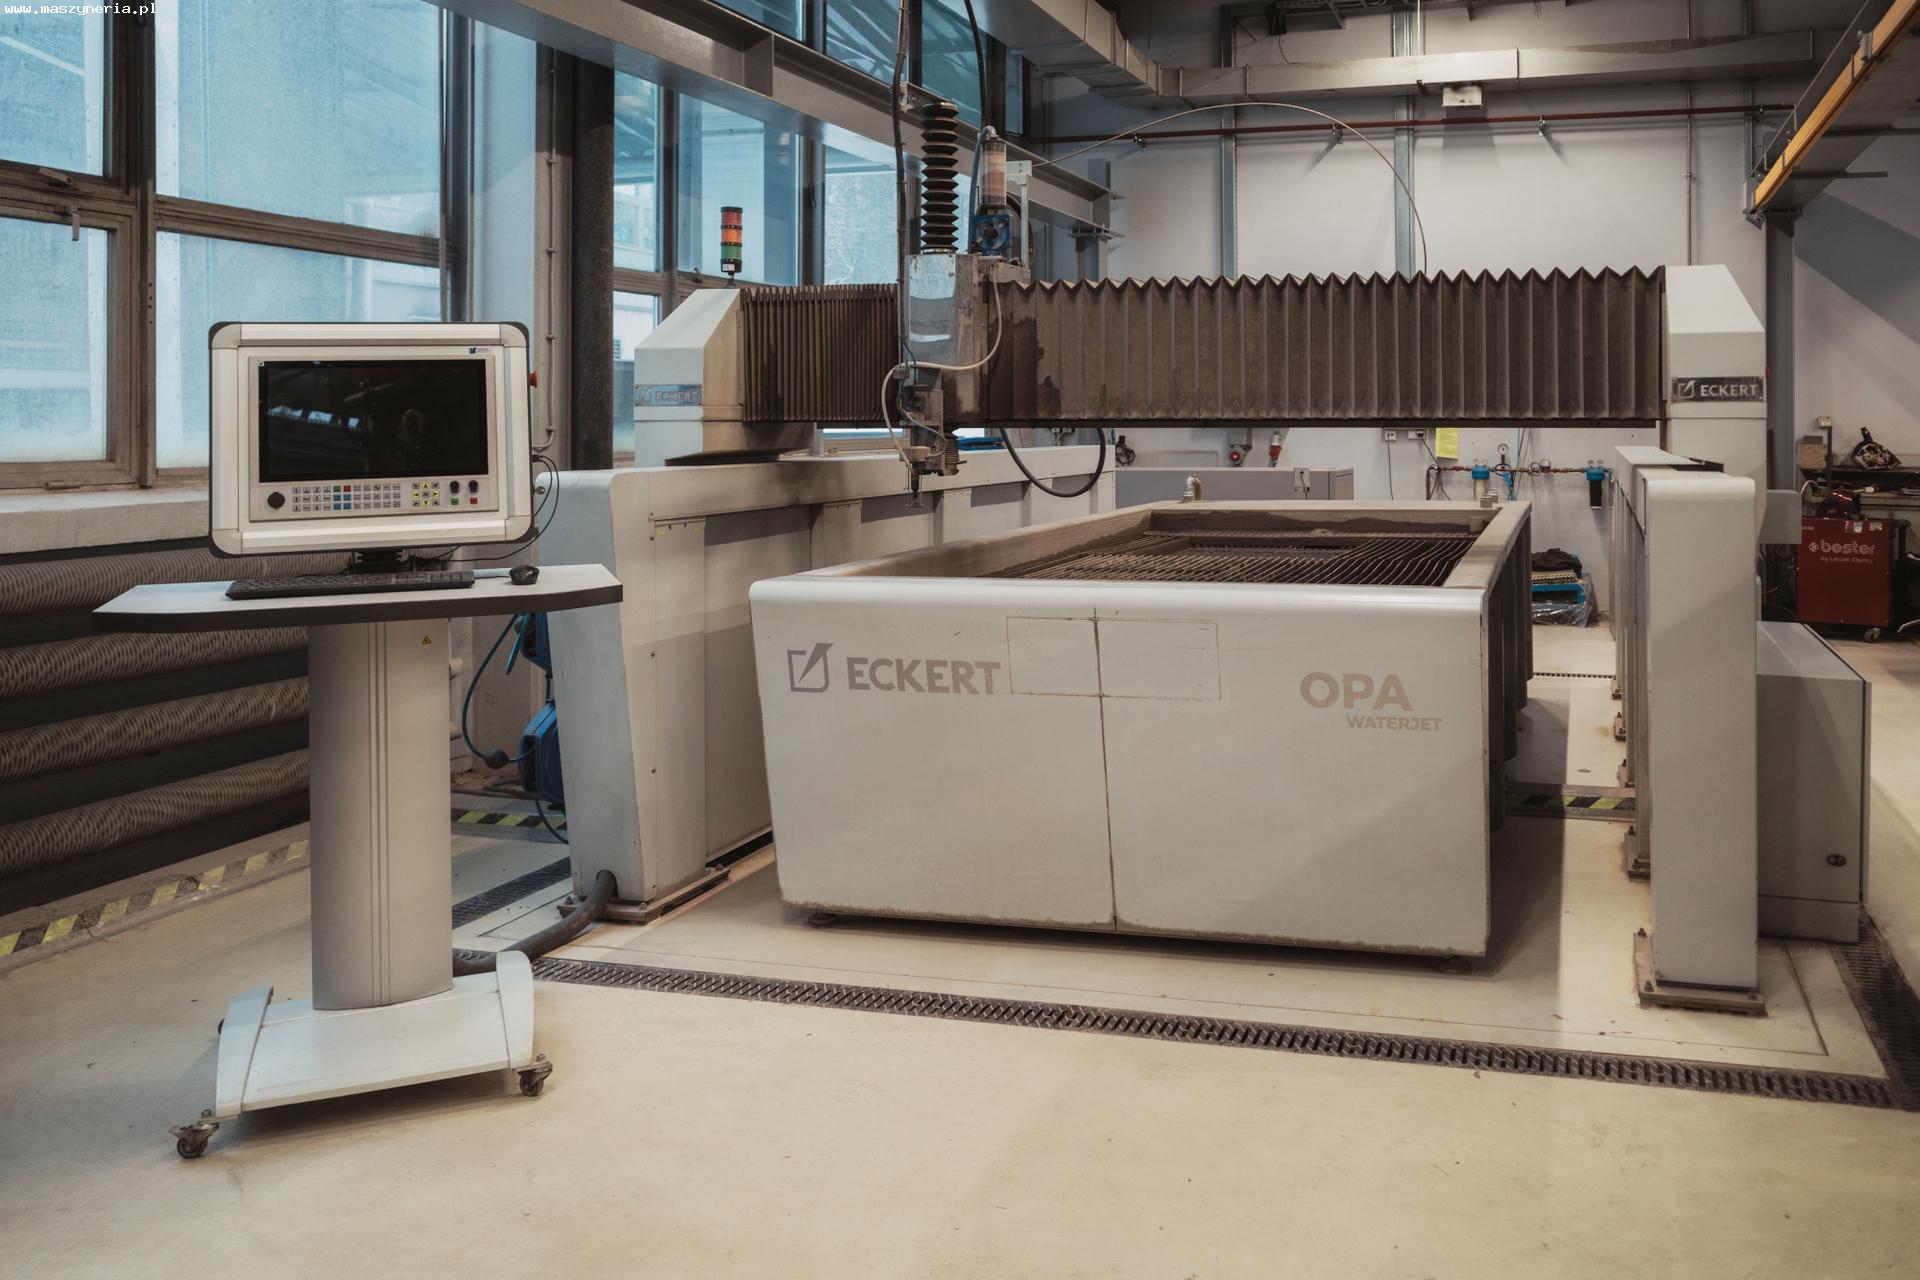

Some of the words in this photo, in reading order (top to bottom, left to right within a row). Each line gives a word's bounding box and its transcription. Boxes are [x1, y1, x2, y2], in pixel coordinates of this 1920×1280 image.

[1700, 384, 1758, 397] ECKERT
[1820, 539, 1876, 555] bester
[846, 657, 1002, 695] ECKERT
[1300, 672, 1414, 711] OPA
[1345, 715, 1443, 731] WATERJET
